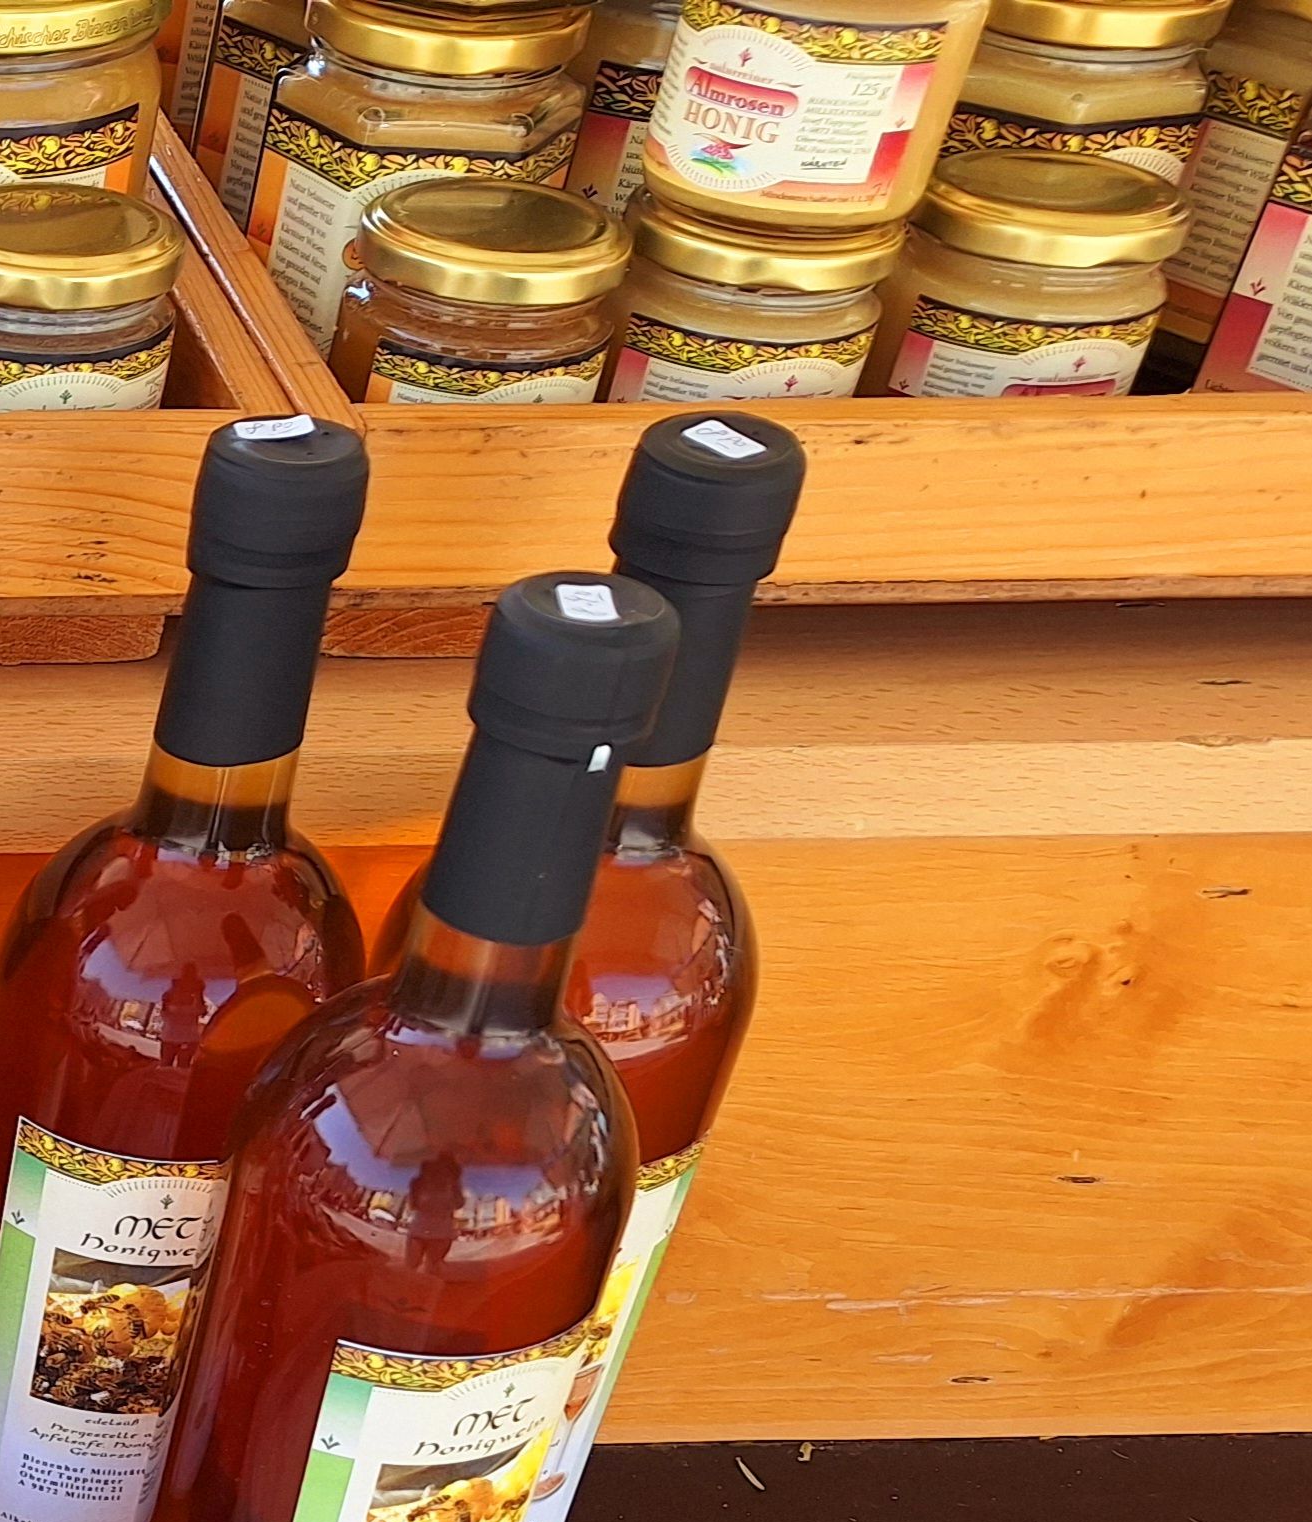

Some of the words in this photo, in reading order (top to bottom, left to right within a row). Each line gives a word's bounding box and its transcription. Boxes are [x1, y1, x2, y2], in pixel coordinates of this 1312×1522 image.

[688, 75, 785, 117] Almrosen
[851, 82, 879, 97] 125
[684, 99, 780, 144] HONIG
[113, 1213, 203, 1241] MET
[452, 1394, 538, 1438] MET
[411, 1415, 547, 1458] Honigwein
[20, 1462, 53, 1476] Josef
[22, 1453, 86, 1474] Bienenhof
[19, 1470, 105, 1493] Obermillstatt
[31, 1483, 58, 1495] 9872
[64, 1490, 121, 1500] Millstatt
